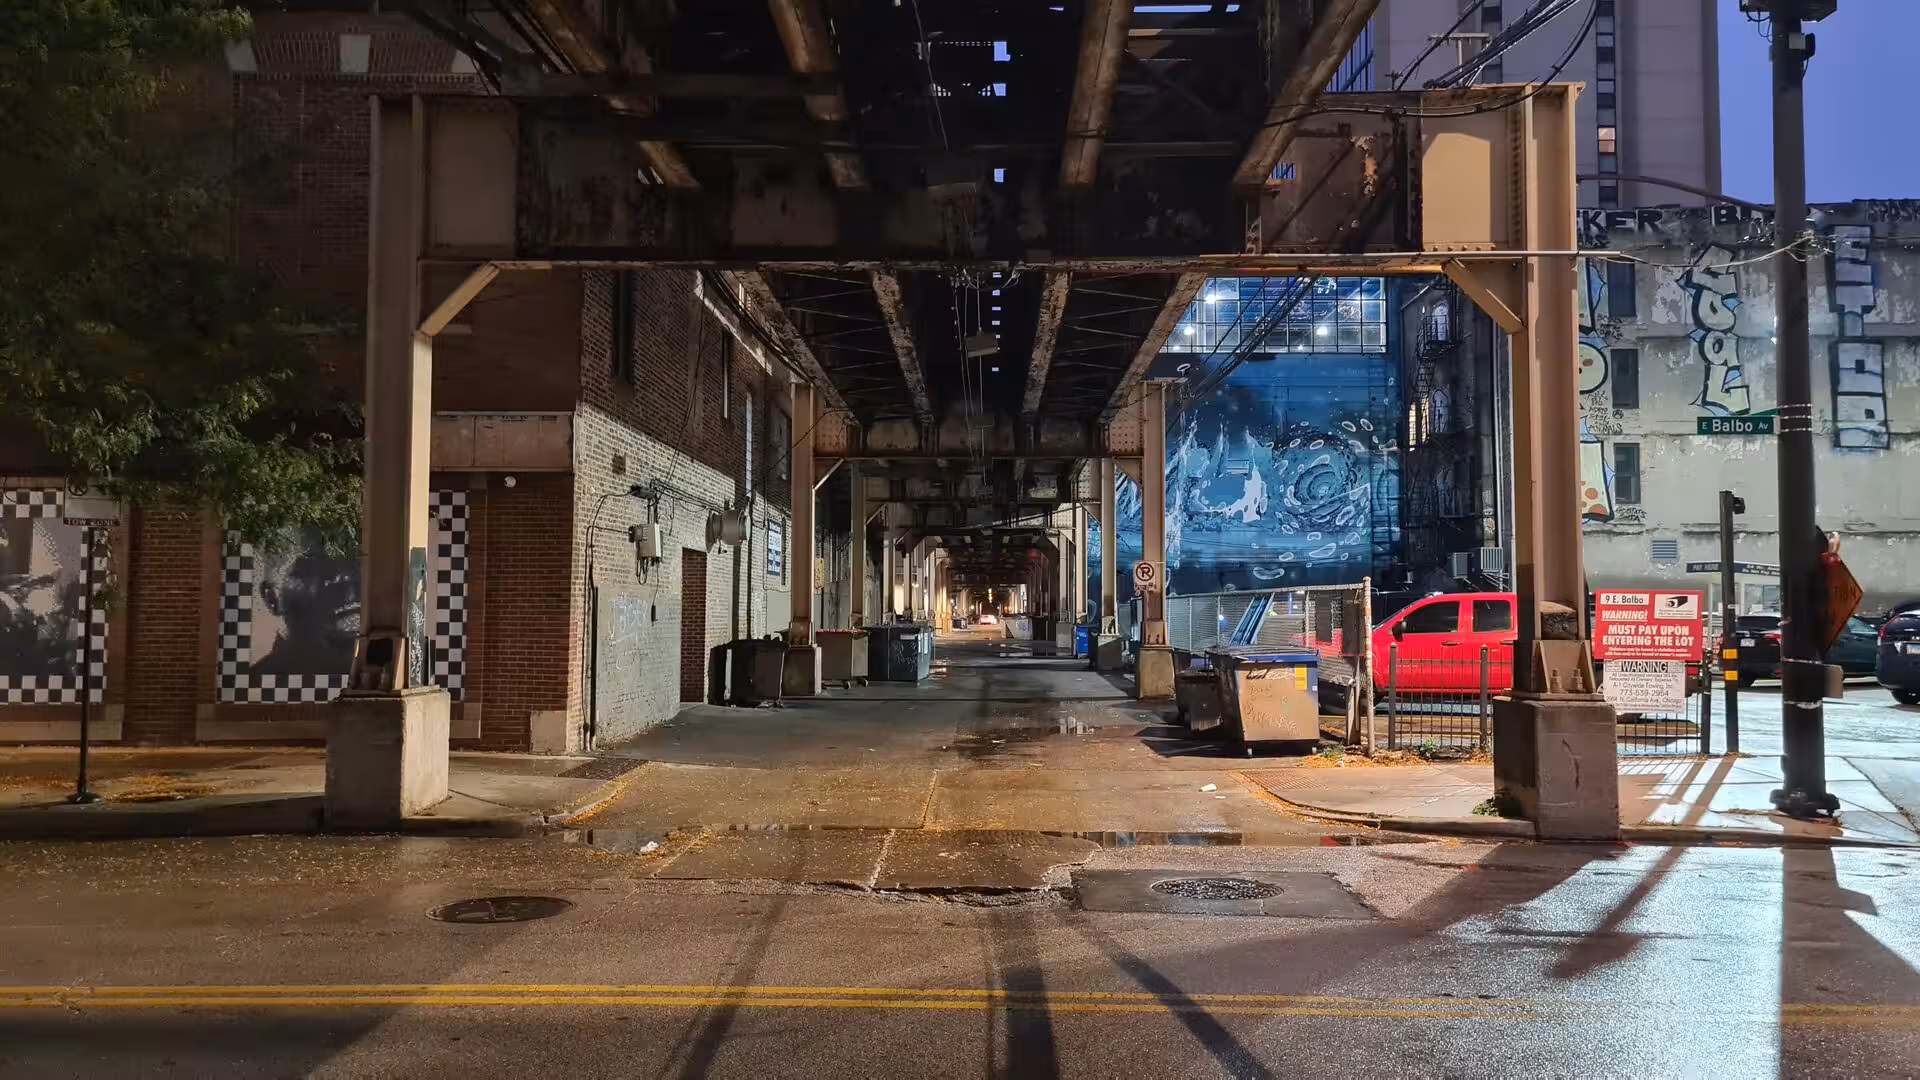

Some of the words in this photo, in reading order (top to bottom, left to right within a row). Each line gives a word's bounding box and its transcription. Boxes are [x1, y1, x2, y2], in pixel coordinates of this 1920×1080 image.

[1712, 419, 1753, 432] Balbo
[1605, 595, 1610, 604] 9
[1612, 595, 1619, 604] E.
[1621, 595, 1644, 604] Balbo
[1601, 609, 1648, 620] WARNING!
[1608, 625, 1636, 635] MUST
[1638, 625, 1658, 635] PAY
[1660, 625, 1689, 636] UPON
[1602, 636, 1652, 646] ENTERING
[1653, 636, 1673, 646] THE
[1675, 636, 1694, 647] LOT
[1622, 661, 1668, 672] WARNING
